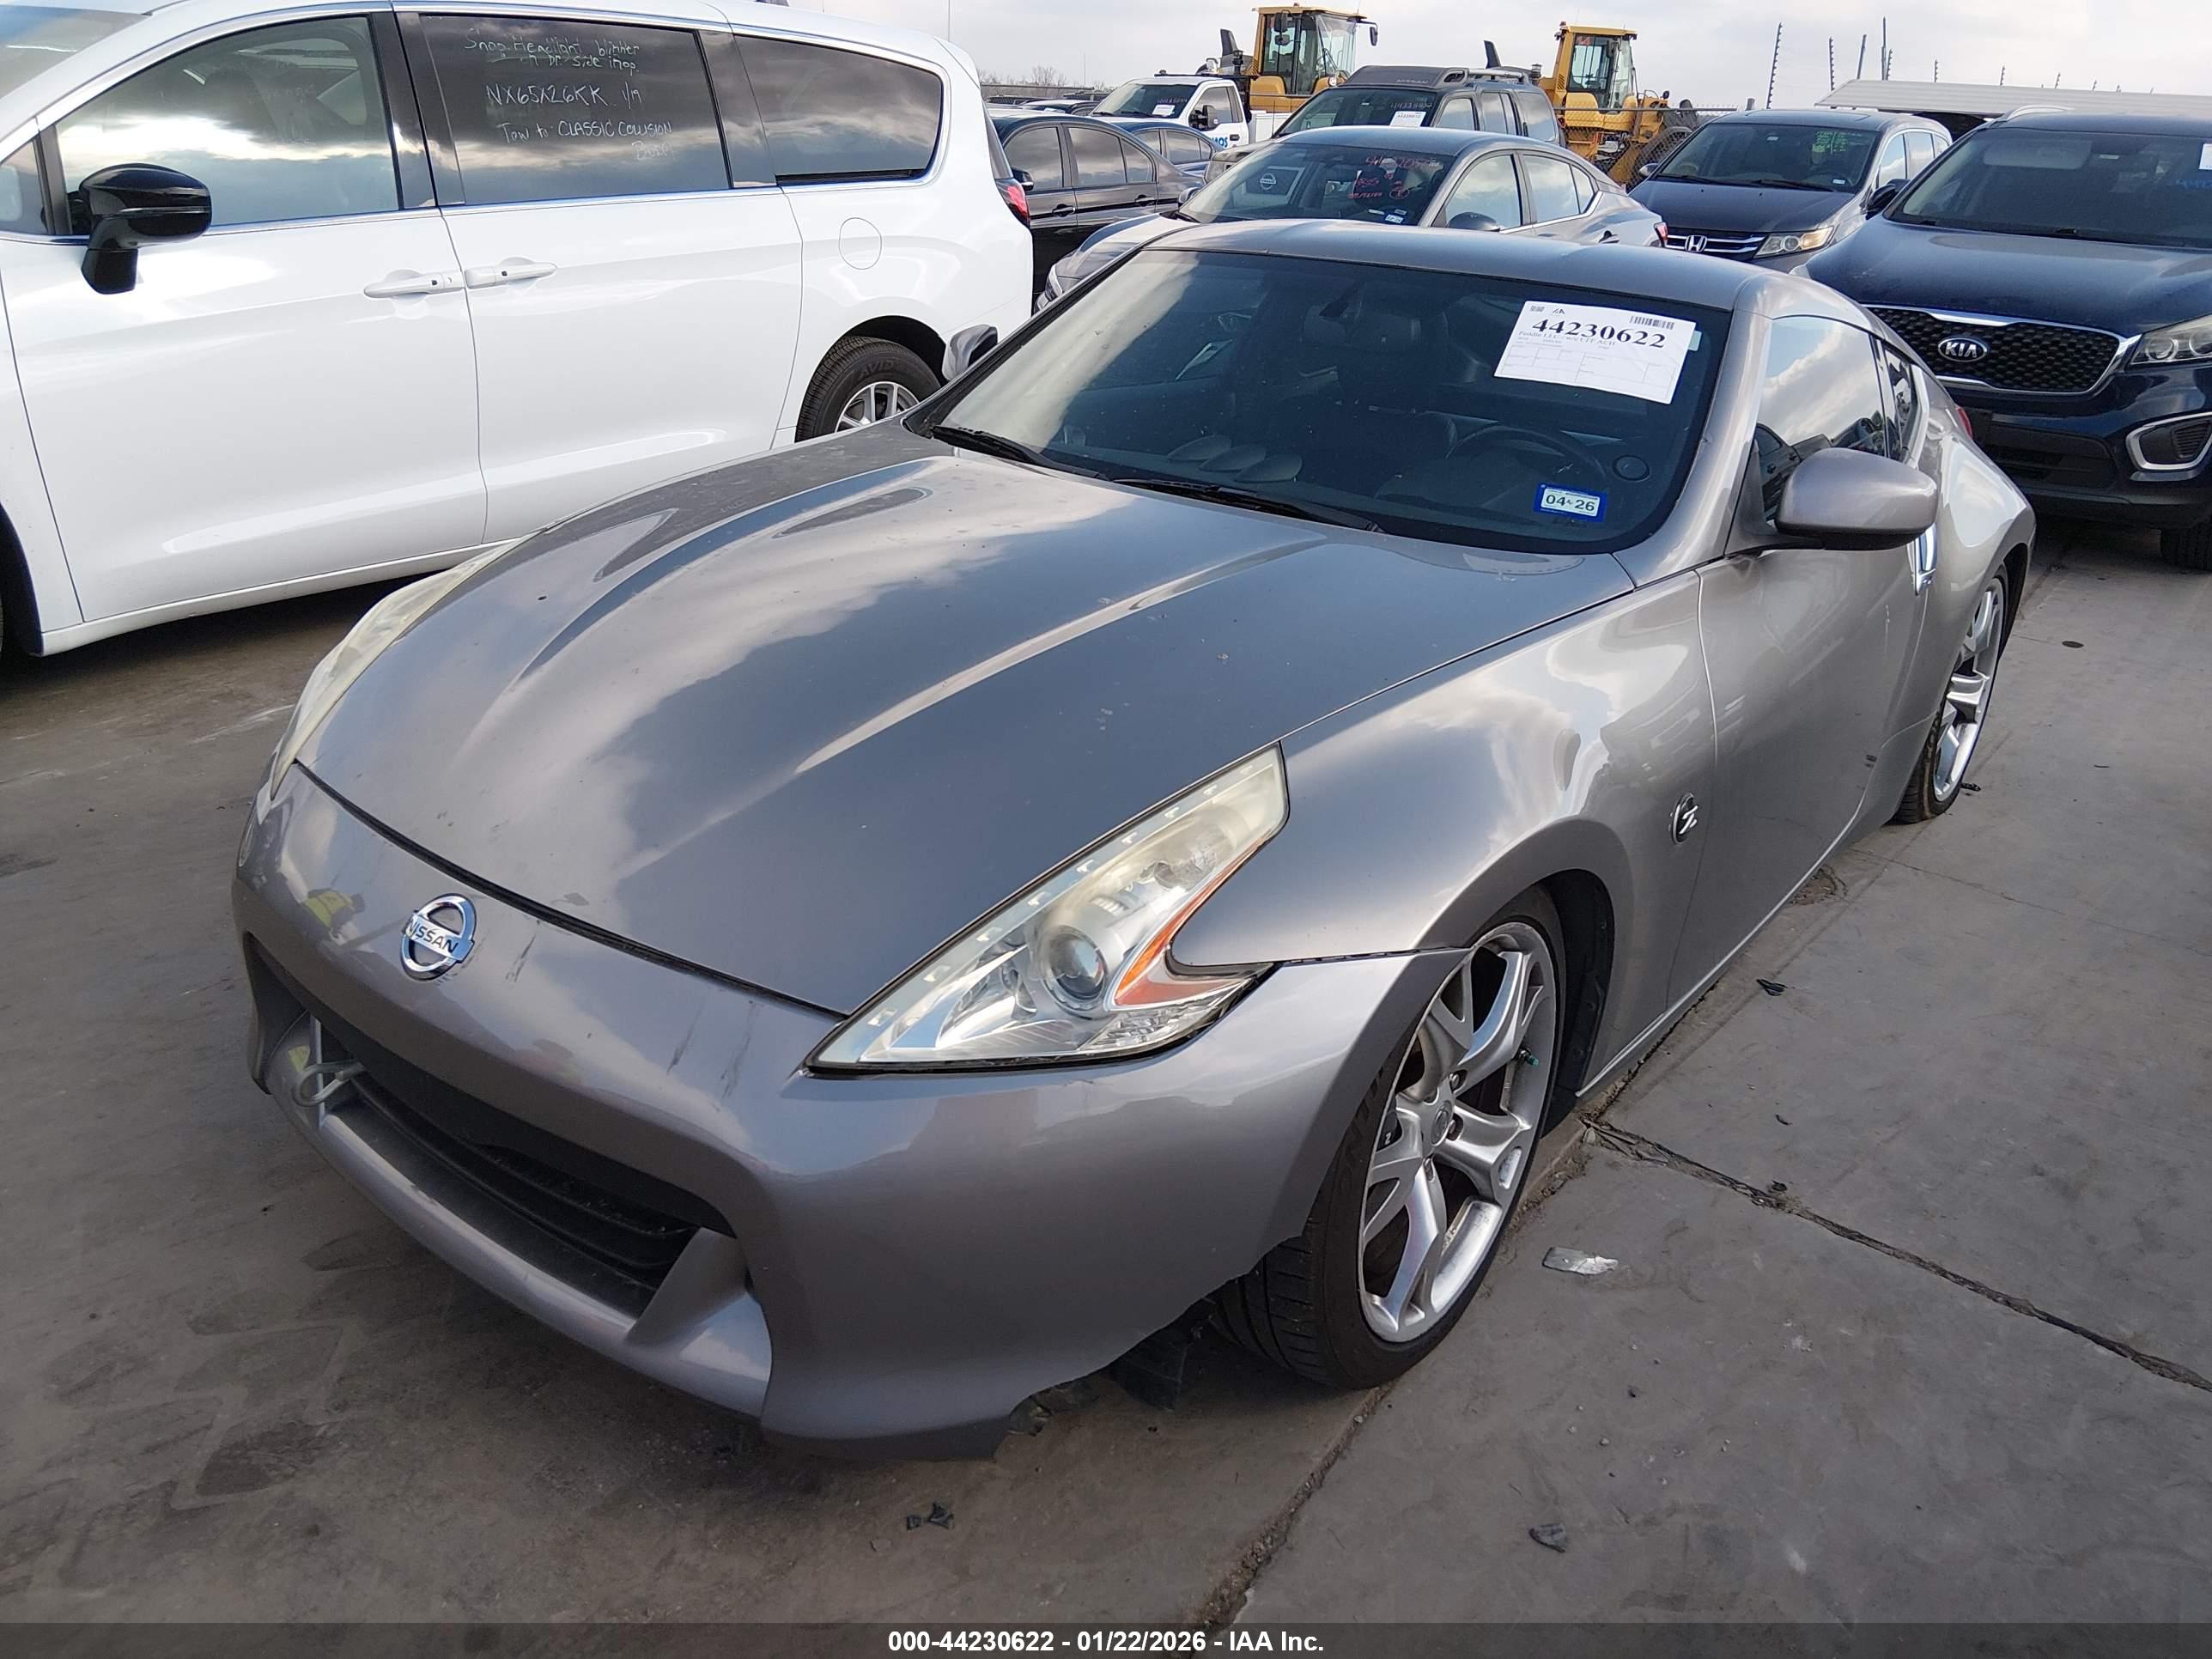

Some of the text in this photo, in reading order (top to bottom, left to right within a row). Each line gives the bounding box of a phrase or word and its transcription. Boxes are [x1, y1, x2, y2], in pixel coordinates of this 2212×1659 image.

[558, 118, 615, 137] CLASSIC
[1532, 319, 1666, 349] 44230622
[1945, 341, 1978, 358] KIA
[410, 921, 459, 954] NISSAN
